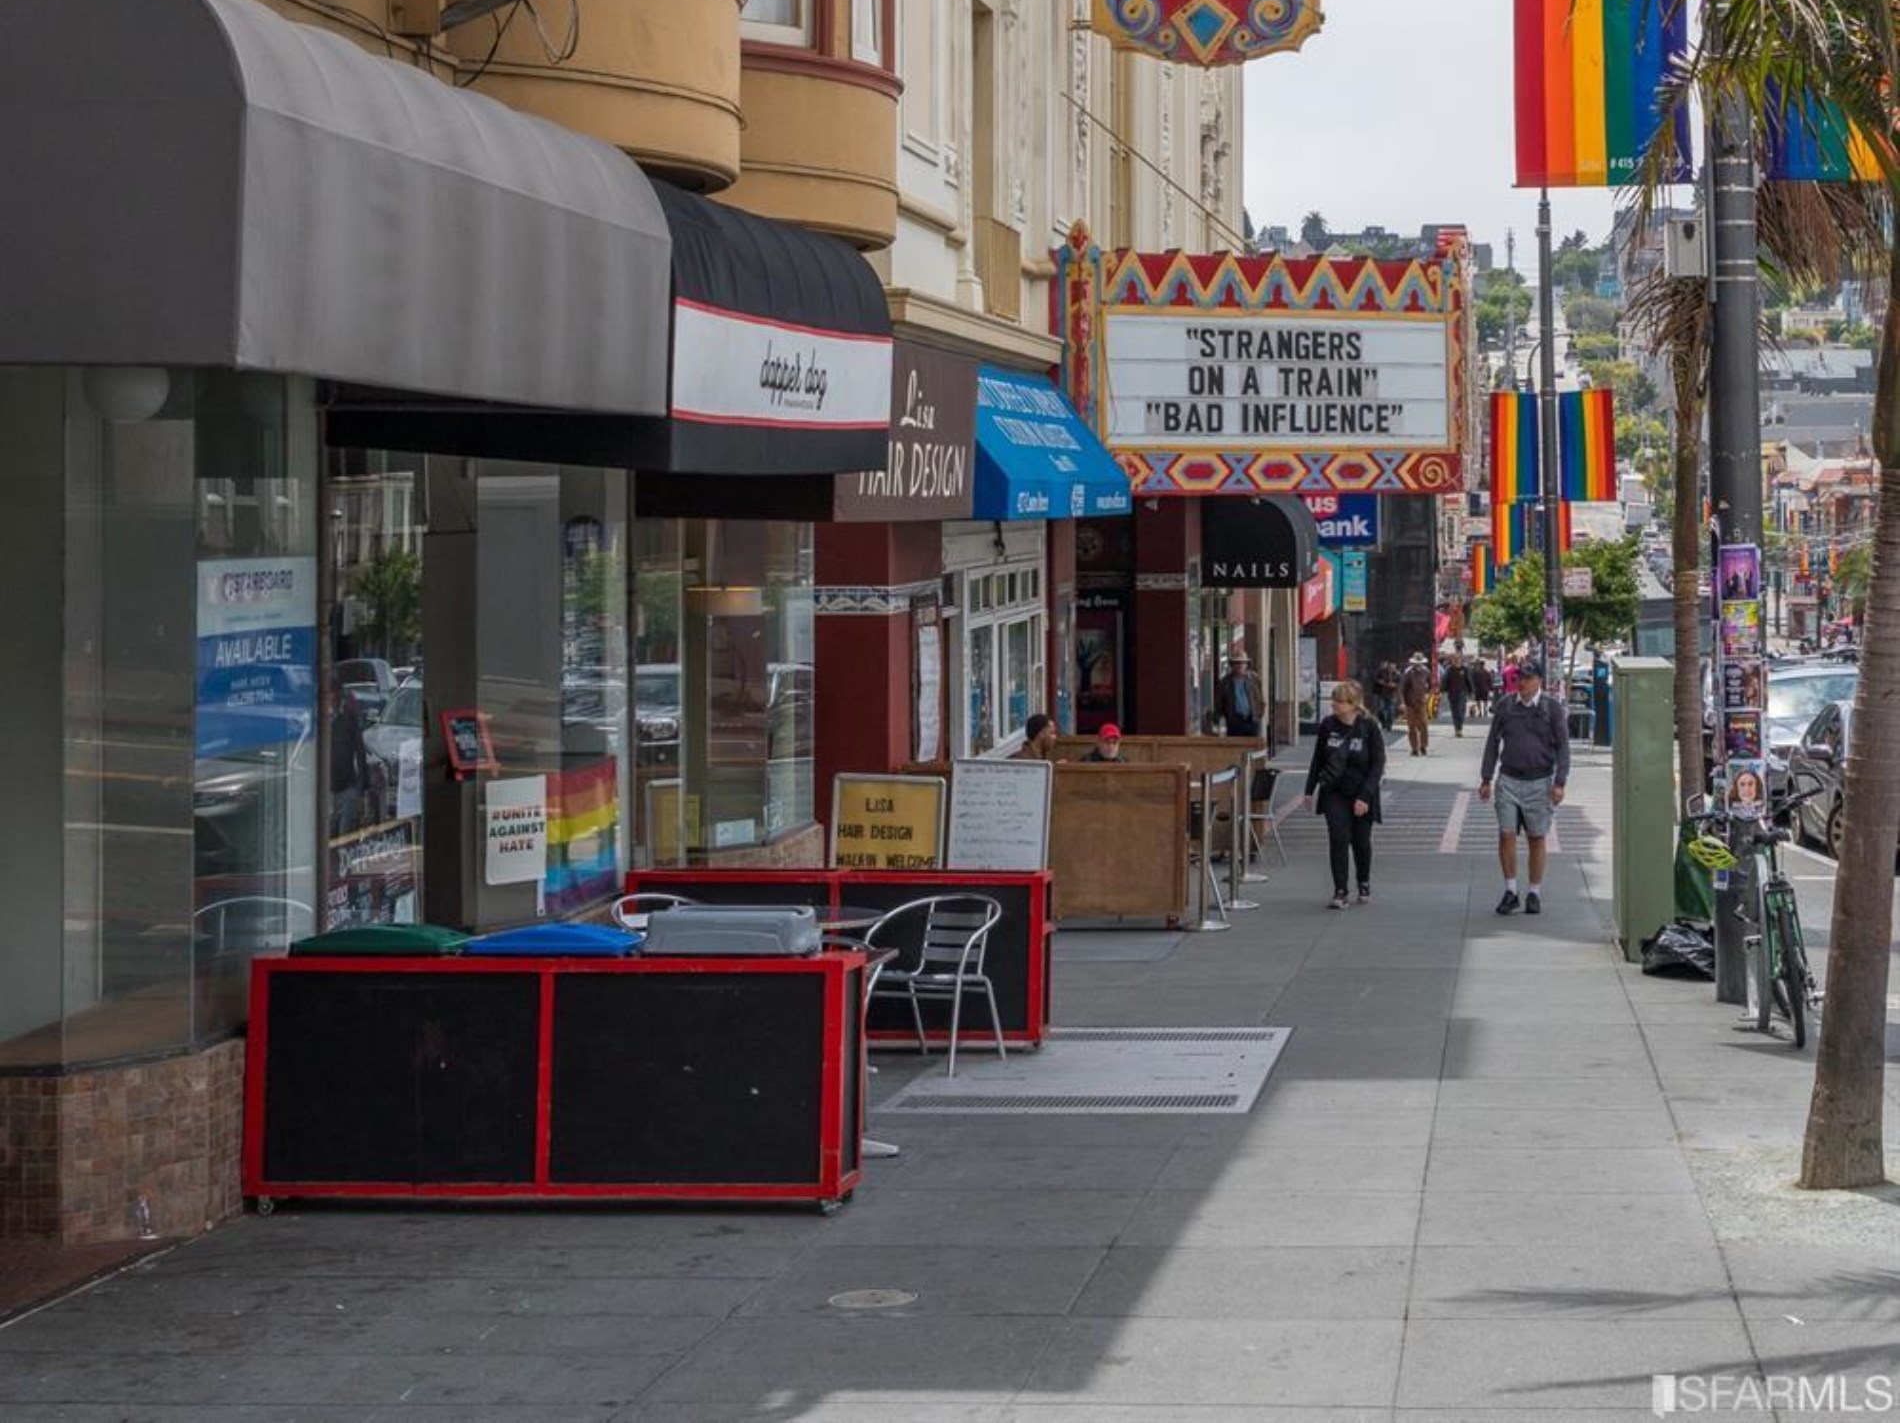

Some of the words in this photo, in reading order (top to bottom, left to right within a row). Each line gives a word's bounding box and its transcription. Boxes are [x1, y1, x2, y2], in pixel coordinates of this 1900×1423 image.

[804, 346, 828, 411] dog
[1187, 365, 1225, 396] ON
[1241, 367, 1261, 396] A
[900, 369, 936, 430] Lisa
[1146, 401, 1223, 433] "BAD
[909, 442, 966, 497] DESIGN
[1316, 513, 1372, 537] ank
[1212, 562, 1290, 578] NAILS
[215, 634, 293, 667] AVAILABLE
[865, 797, 894, 813] LISA
[489, 821, 546, 839] AGAINST
[837, 823, 864, 839] HAIR
[870, 825, 913, 841] DESIGN
[499, 839, 534, 853] HATE
